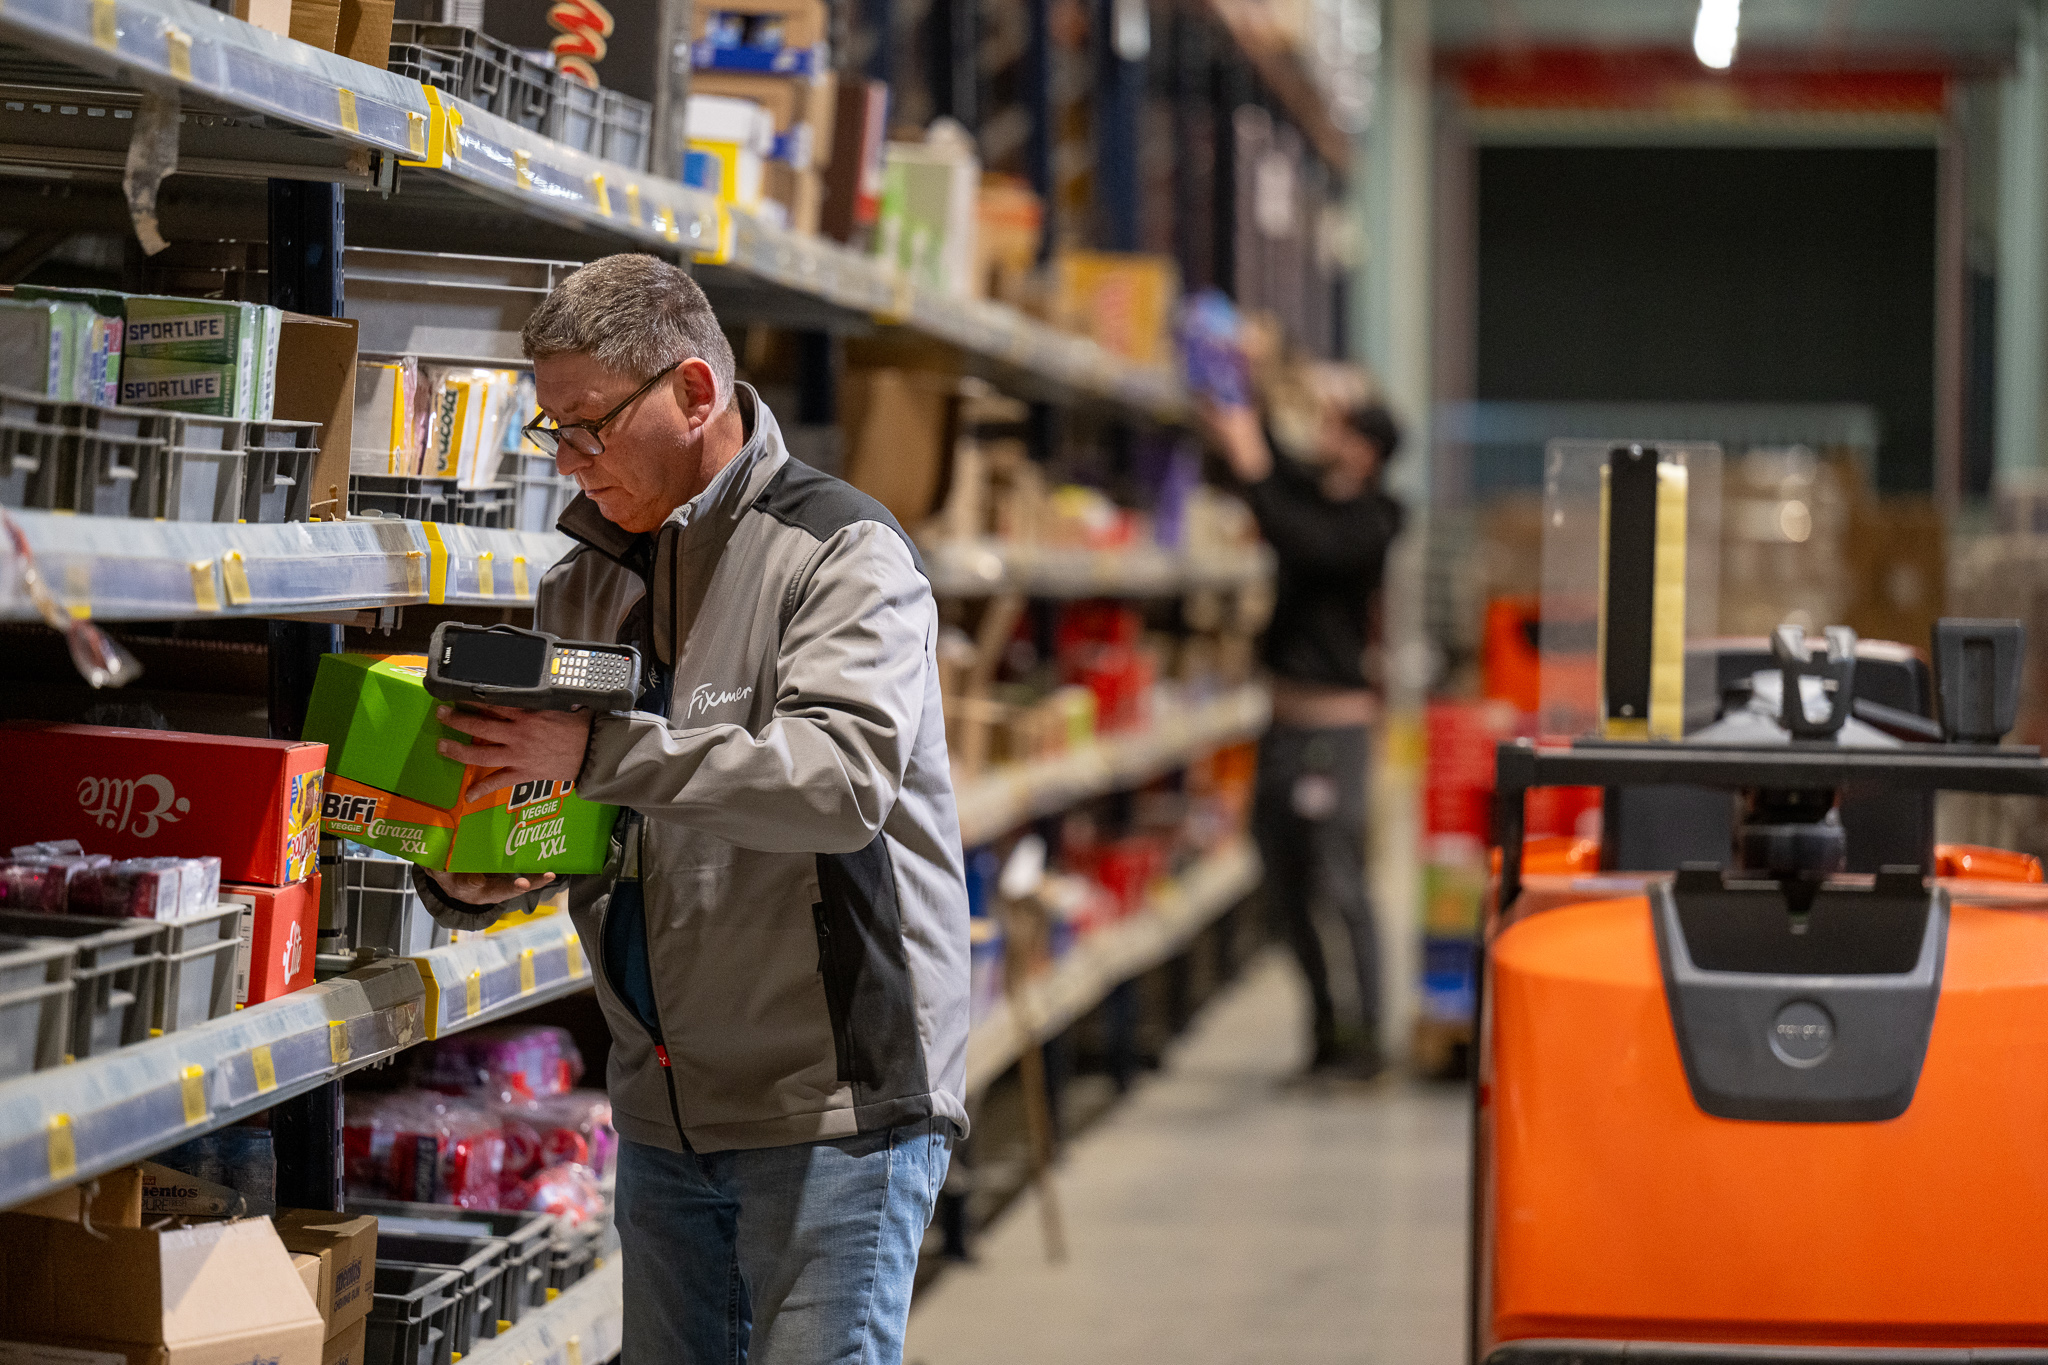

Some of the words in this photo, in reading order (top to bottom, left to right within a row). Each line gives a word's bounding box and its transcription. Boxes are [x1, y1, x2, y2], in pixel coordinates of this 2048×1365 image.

[129, 319, 219, 340] SPORTLIFE
[125, 378, 215, 399] SPORTLIFE
[687, 683, 753, 720] Fixmer
[77, 773, 191, 838] Elite
[322, 792, 378, 824] BiFi
[367, 818, 424, 840] Carazza
[505, 816, 565, 856] Carazza
[399, 839, 429, 855] XXL
[537, 834, 567, 861] XXL
